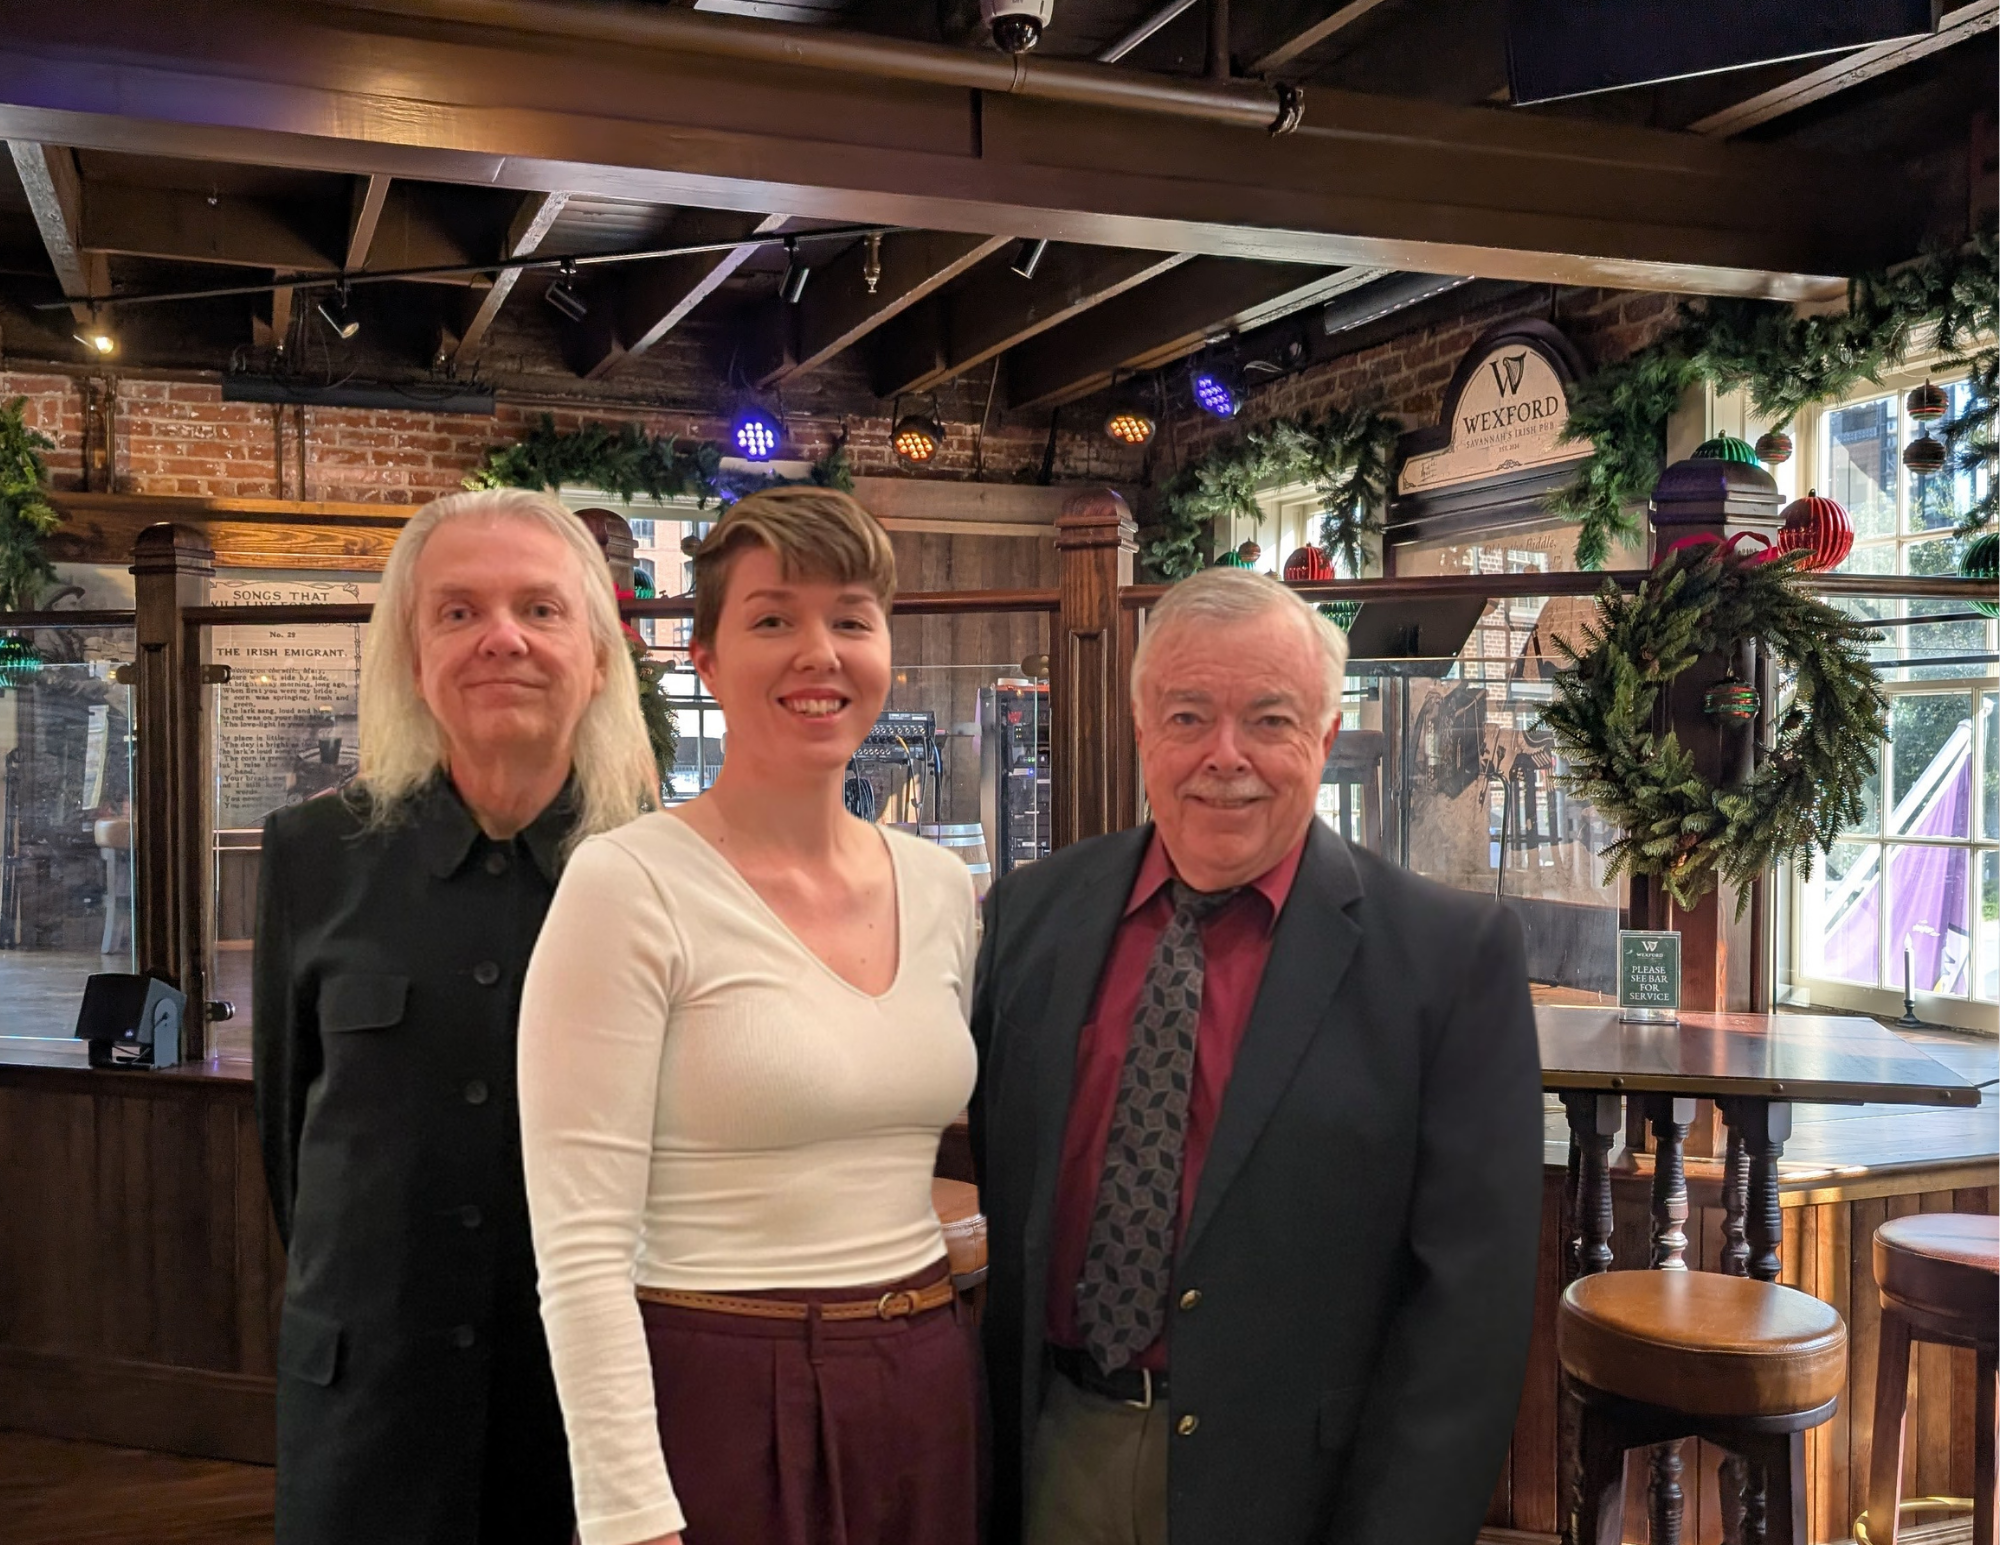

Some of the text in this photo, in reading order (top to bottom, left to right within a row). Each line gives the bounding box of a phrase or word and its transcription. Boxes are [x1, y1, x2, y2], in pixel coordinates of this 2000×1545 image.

[1463, 396, 1558, 434] WEXFORD
[1466, 431, 1513, 449] SAVANNAH'S
[1515, 425, 1537, 438] IRISH
[233, 590, 330, 602] SONGS THAT
[216, 648, 348, 658] THE IRISH EMIGRANT.
[315, 680, 331, 688] long
[241, 720, 276, 728] love-light
[224, 774, 244, 782] Your
[1632, 966, 1667, 974] PLEASE
[1631, 975, 1669, 984] SEE BAR
[1640, 984, 1660, 992] FOR
[1630, 993, 1670, 1001] SERVICE
